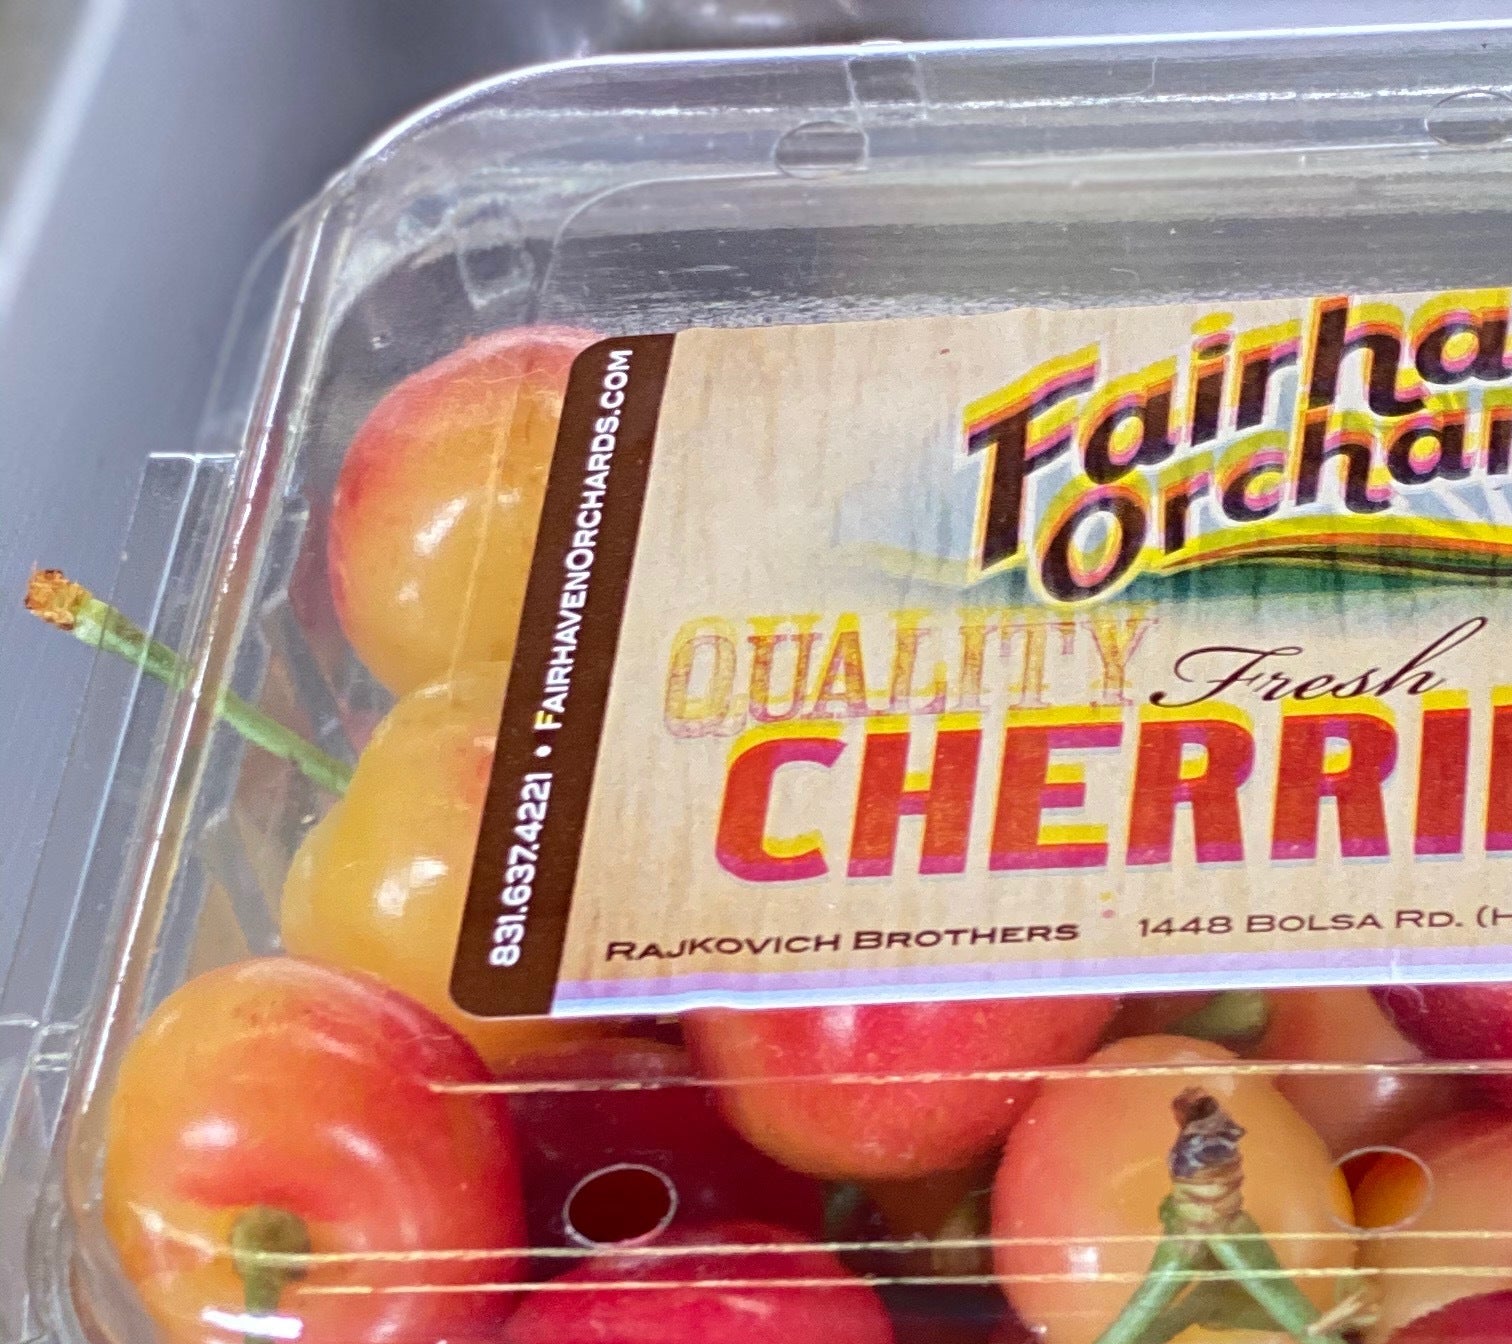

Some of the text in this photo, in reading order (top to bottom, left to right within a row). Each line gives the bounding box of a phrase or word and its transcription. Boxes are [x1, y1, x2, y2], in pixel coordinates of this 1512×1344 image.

[487, 348, 634, 968] 831.637.4221 FAIRHAVENORCHARDS.COM
[663, 604, 1489, 738] QUALITY Fresh
[604, 931, 841, 963] RAJKOVICH
[852, 922, 1081, 952] BROTHERS
[1138, 915, 1234, 938] 1448
[1245, 911, 1383, 935] BOLSA
[1394, 909, 1464, 930] RD.
